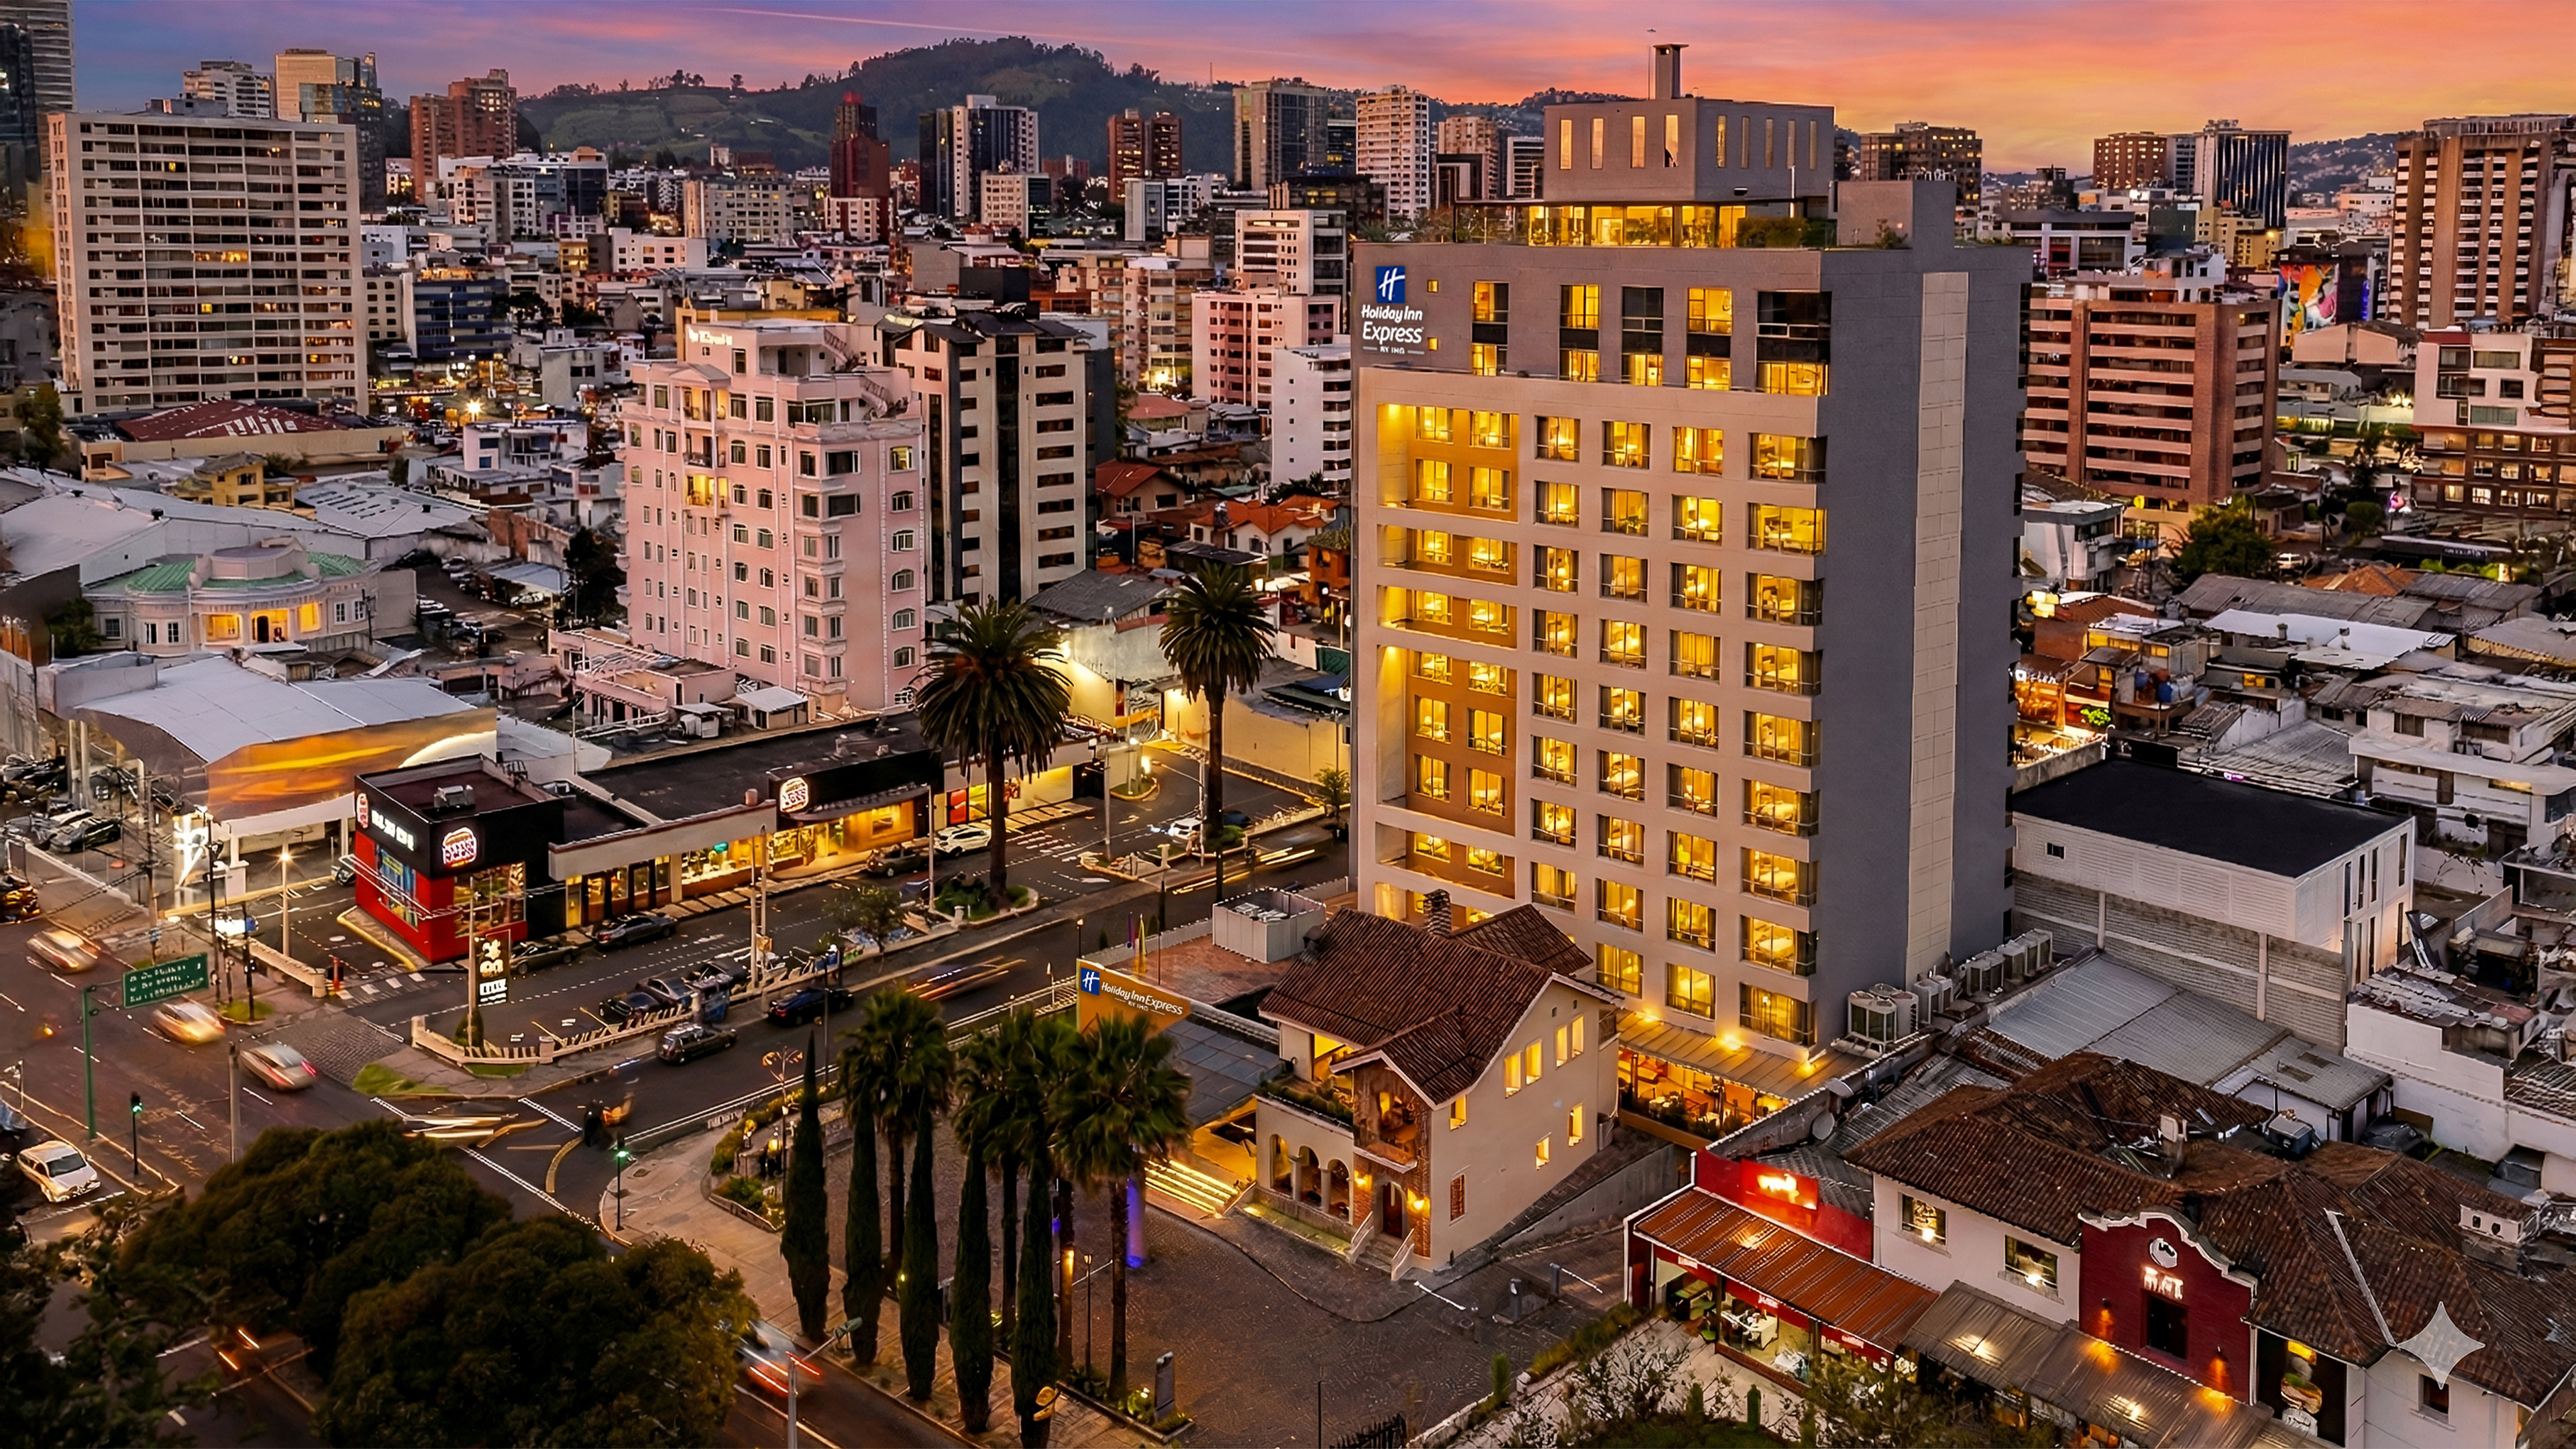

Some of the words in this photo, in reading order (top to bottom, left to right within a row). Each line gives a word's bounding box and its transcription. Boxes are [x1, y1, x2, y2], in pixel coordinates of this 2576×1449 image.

[1361, 304, 1403, 323] Holiday
[1404, 306, 1423, 321] Inn
[1362, 321, 1423, 345] Express
[1101, 982, 1131, 1000] Holiday
[1131, 990, 1145, 1002] Inn
[1145, 996, 1183, 1015] Express
